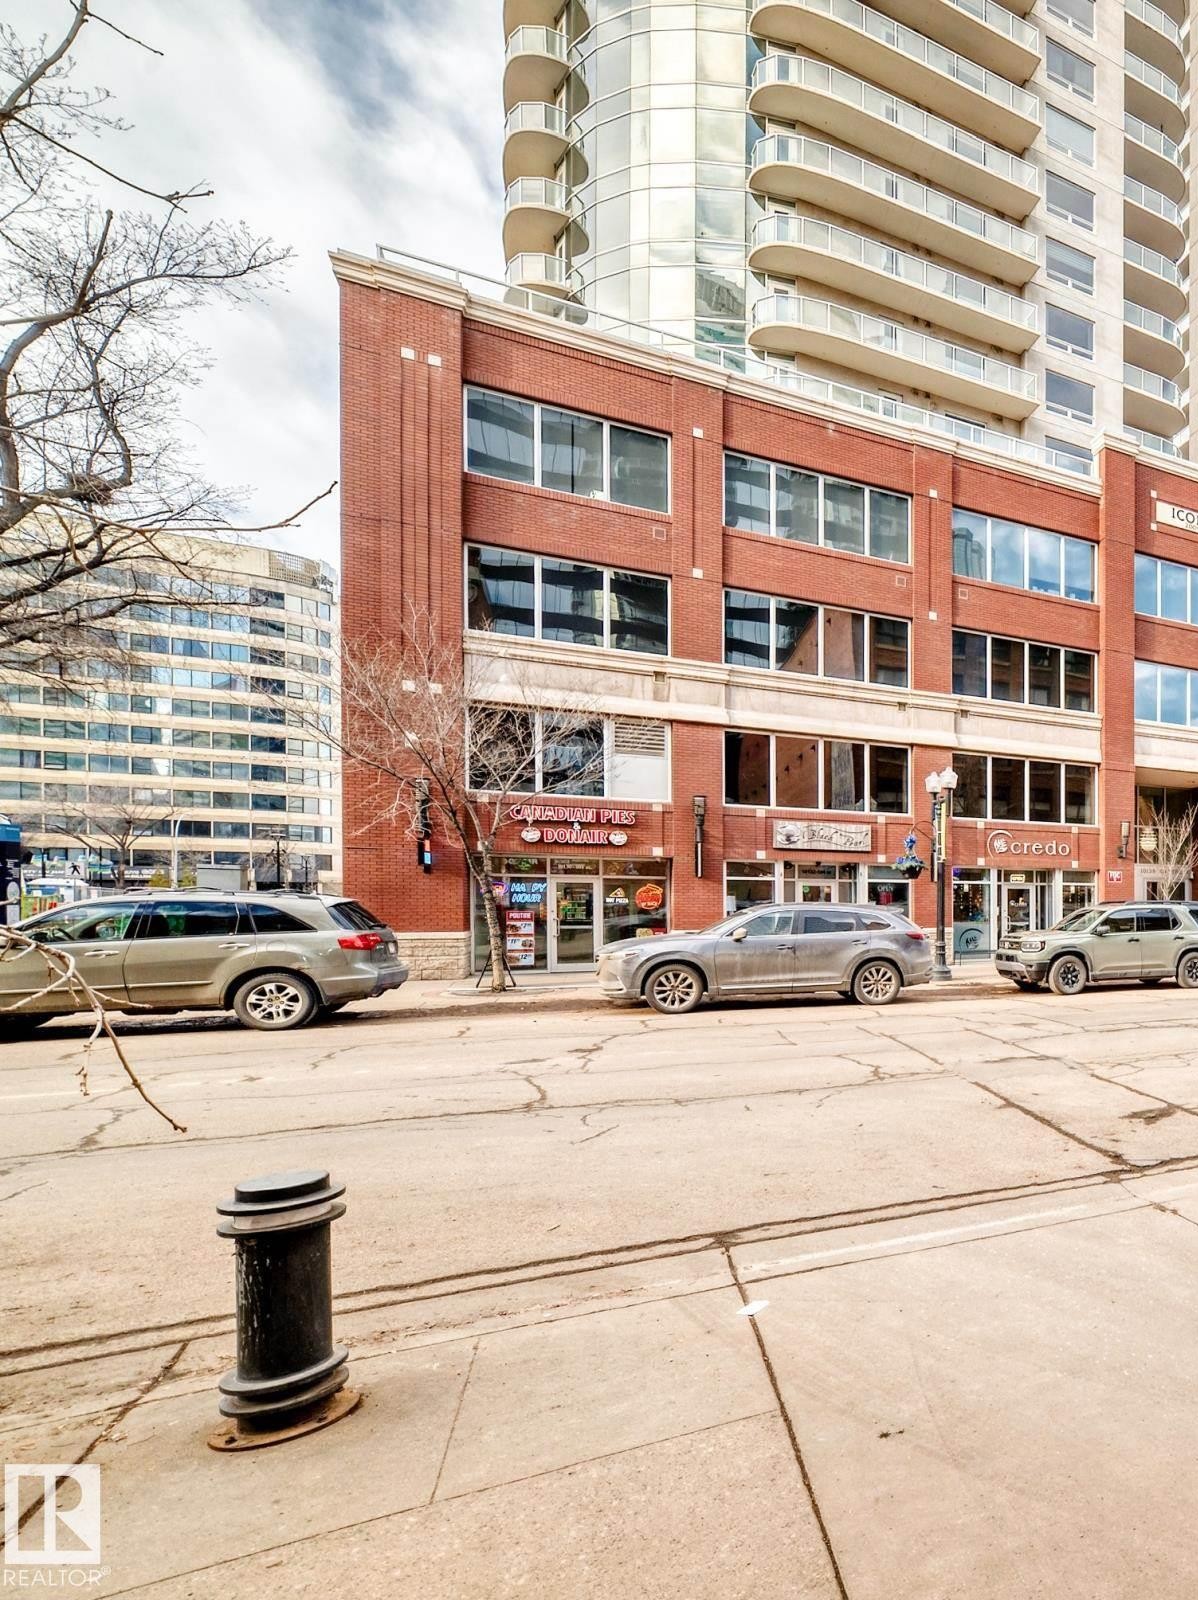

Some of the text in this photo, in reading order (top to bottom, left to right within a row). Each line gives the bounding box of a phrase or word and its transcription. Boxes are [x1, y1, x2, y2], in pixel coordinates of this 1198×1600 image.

[510, 805, 636, 825] CANADIAN PIES
[573, 822, 581, 830] &
[543, 828, 609, 844] DONAIR
[1010, 840, 1070, 856] credo
[510, 882, 547, 893] HAPY
[877, 884, 894, 892] OPEN
[512, 893, 542, 903] HOUR
